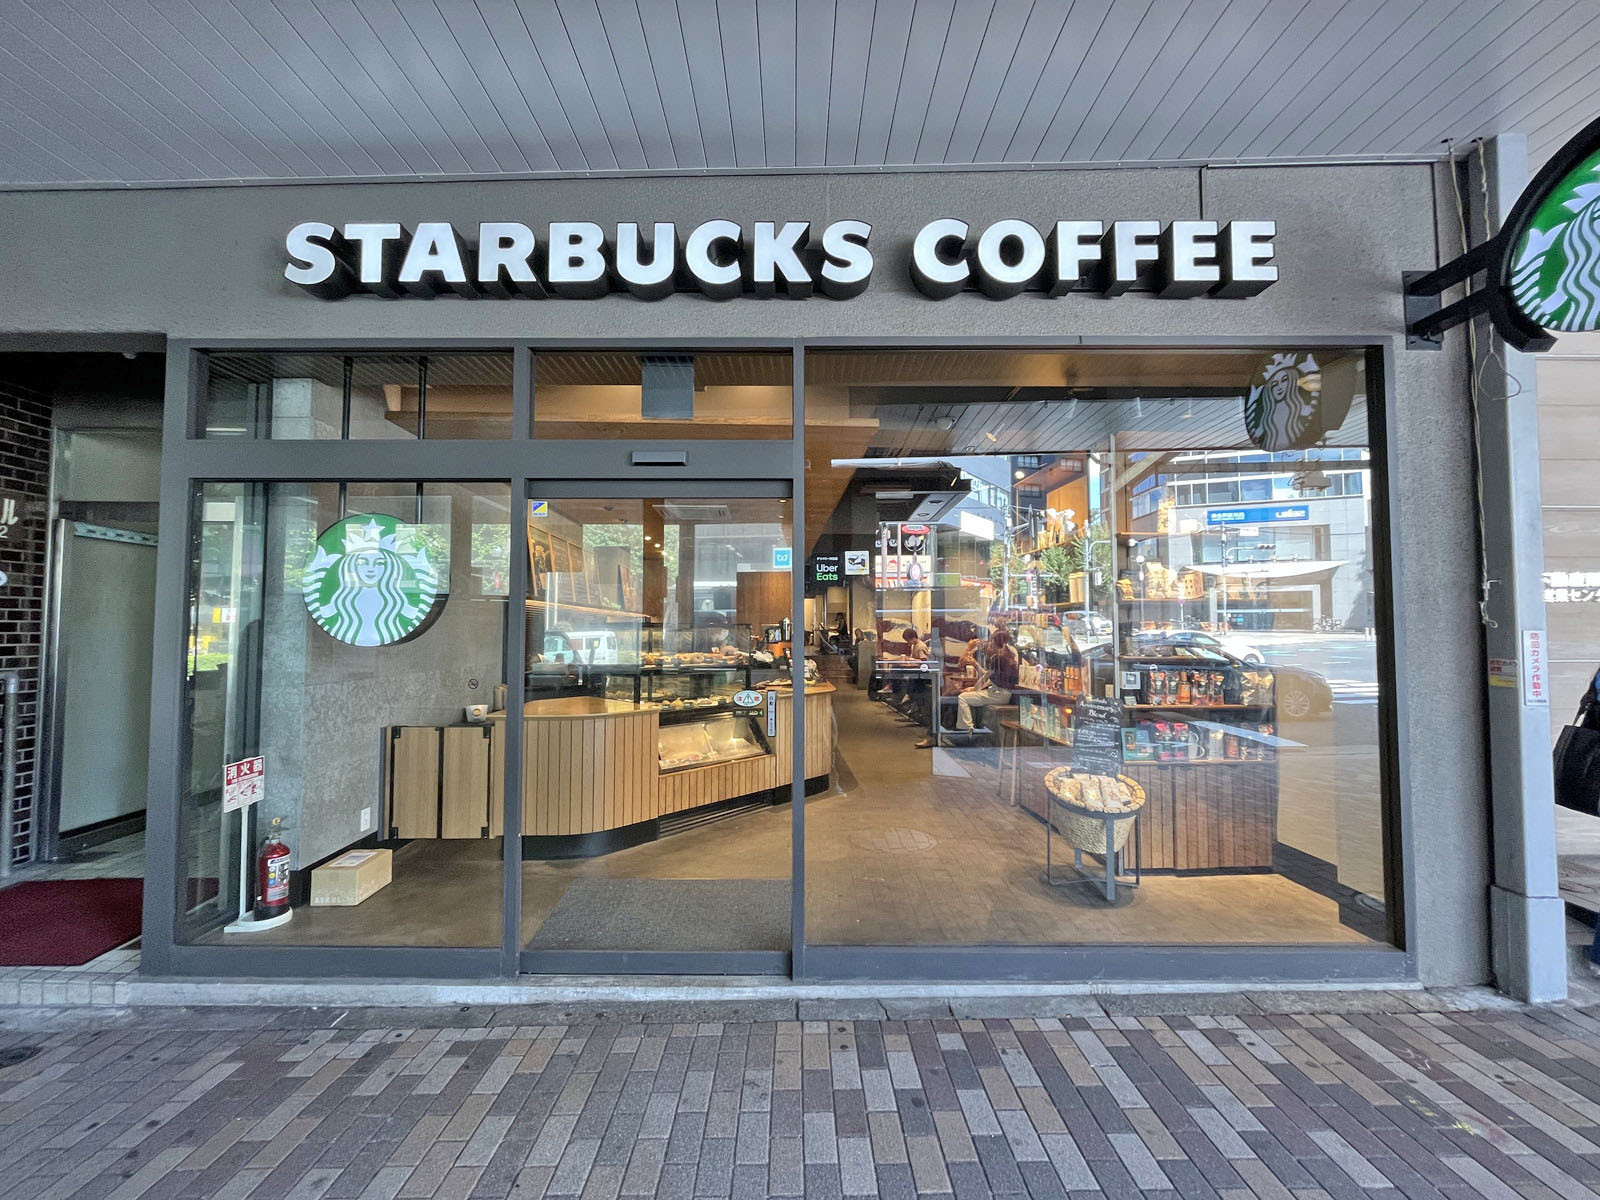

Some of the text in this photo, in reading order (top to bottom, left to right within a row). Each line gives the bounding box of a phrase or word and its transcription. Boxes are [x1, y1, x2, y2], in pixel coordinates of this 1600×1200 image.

[285, 219, 1277, 284] STARBUCKS COFFEE
[816, 564, 839, 572] Uber
[816, 573, 839, 581] Eats
